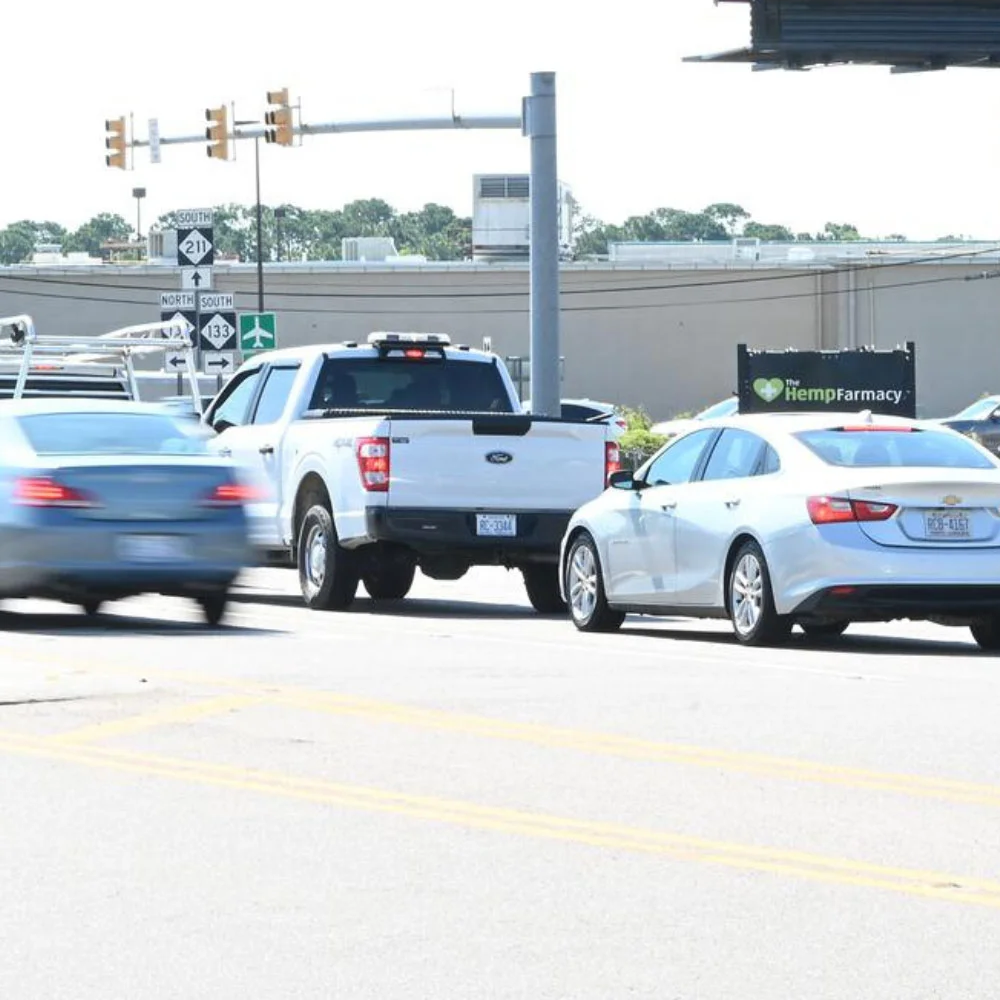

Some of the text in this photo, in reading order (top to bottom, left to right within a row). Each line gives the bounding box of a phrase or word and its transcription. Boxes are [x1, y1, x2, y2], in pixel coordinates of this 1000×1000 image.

[179, 211, 211, 223] SOUTH
[185, 240, 206, 254] 211
[161, 294, 194, 306] NORTH
[201, 296, 232, 307] SOUTH
[207, 325, 230, 339] 133
[785, 379, 799, 387] The
[785, 387, 902, 404] HempFarmacy
